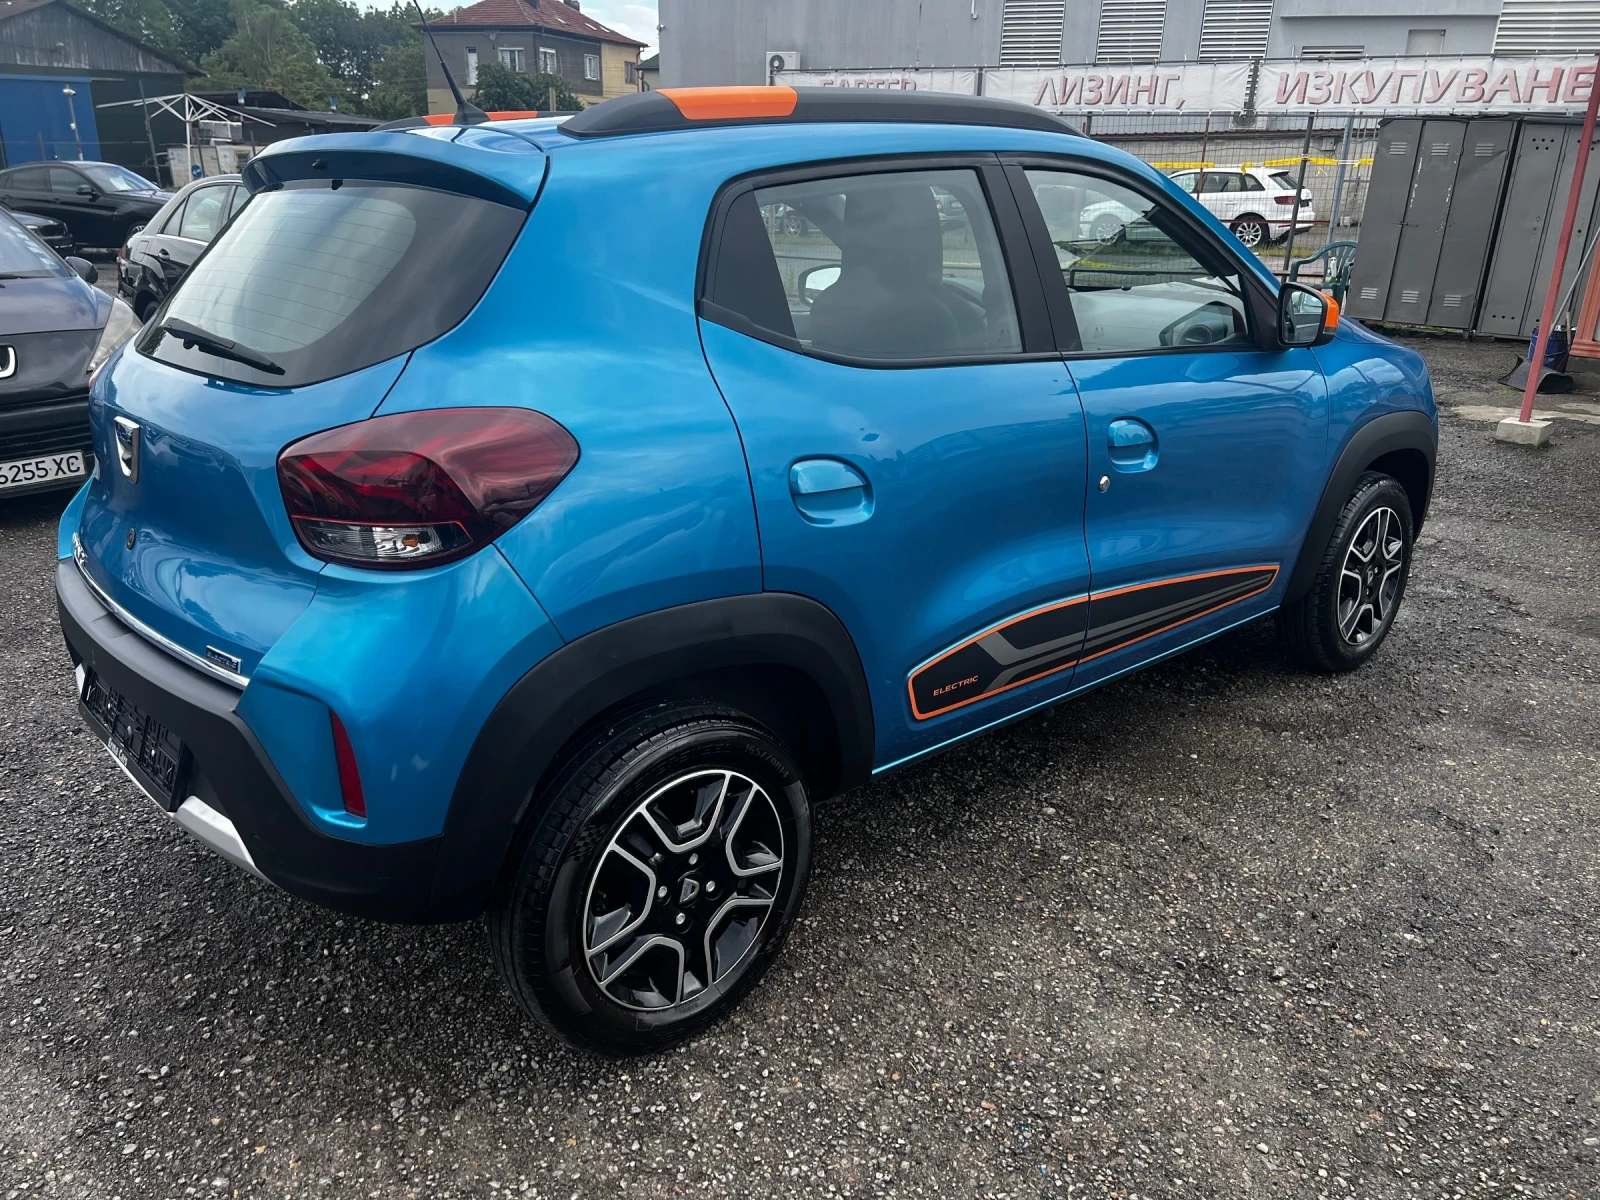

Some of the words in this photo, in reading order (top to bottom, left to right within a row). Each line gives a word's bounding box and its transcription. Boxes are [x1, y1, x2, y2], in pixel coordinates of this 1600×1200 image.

[1034, 74, 1186, 109] ЛИЗИНГ,
[1275, 66, 1597, 105] ИЗКУПУВАНЕ
[933, 675, 979, 697] ELECTRIC
